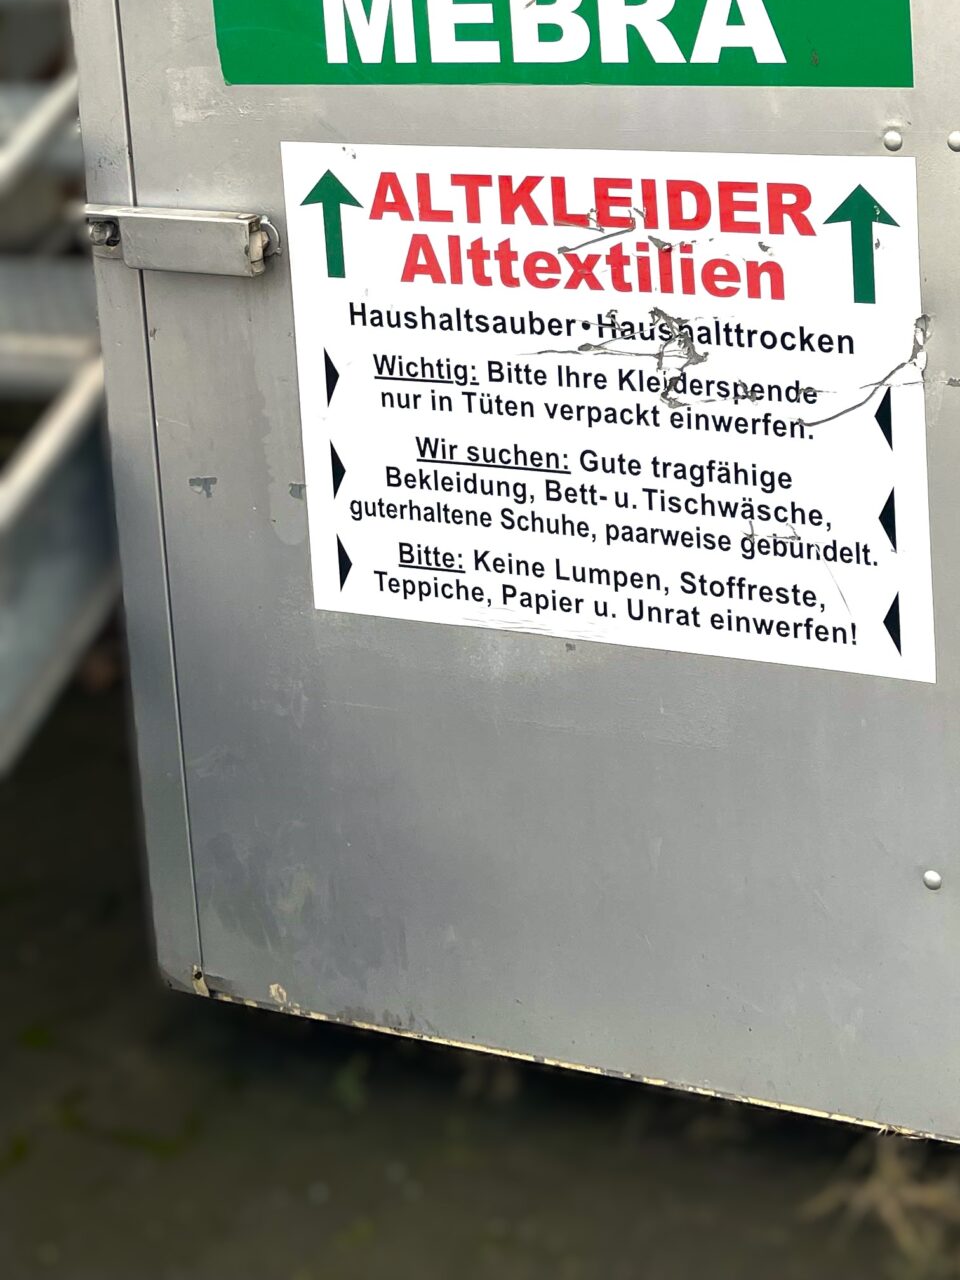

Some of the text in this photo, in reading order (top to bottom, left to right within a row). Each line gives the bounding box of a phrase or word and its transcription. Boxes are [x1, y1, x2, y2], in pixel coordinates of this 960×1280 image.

[369, 171, 817, 237] ALTKLEIDER
[401, 233, 786, 301] Alttextilien
[373, 353, 818, 405] Wichtig: Bitte Ihre Kleiderspende
[381, 389, 814, 440] nur in Tüten verpackt einwerfen.
[415, 436, 793, 494] Wir suchen: Gute tragfähige
[350, 498, 492, 528] guterhaltene
[500, 508, 597, 542] Schuhe,
[605, 523, 732, 552] paarweise
[386, 466, 535, 504] Bekleidung,
[642, 488, 832, 532] Tischwäsche,
[374, 570, 858, 646] Teppiche, Papier u. Unrat einwerfen!
[398, 542, 826, 613] Bitte: Keine Lumpen, Stoffreste,
